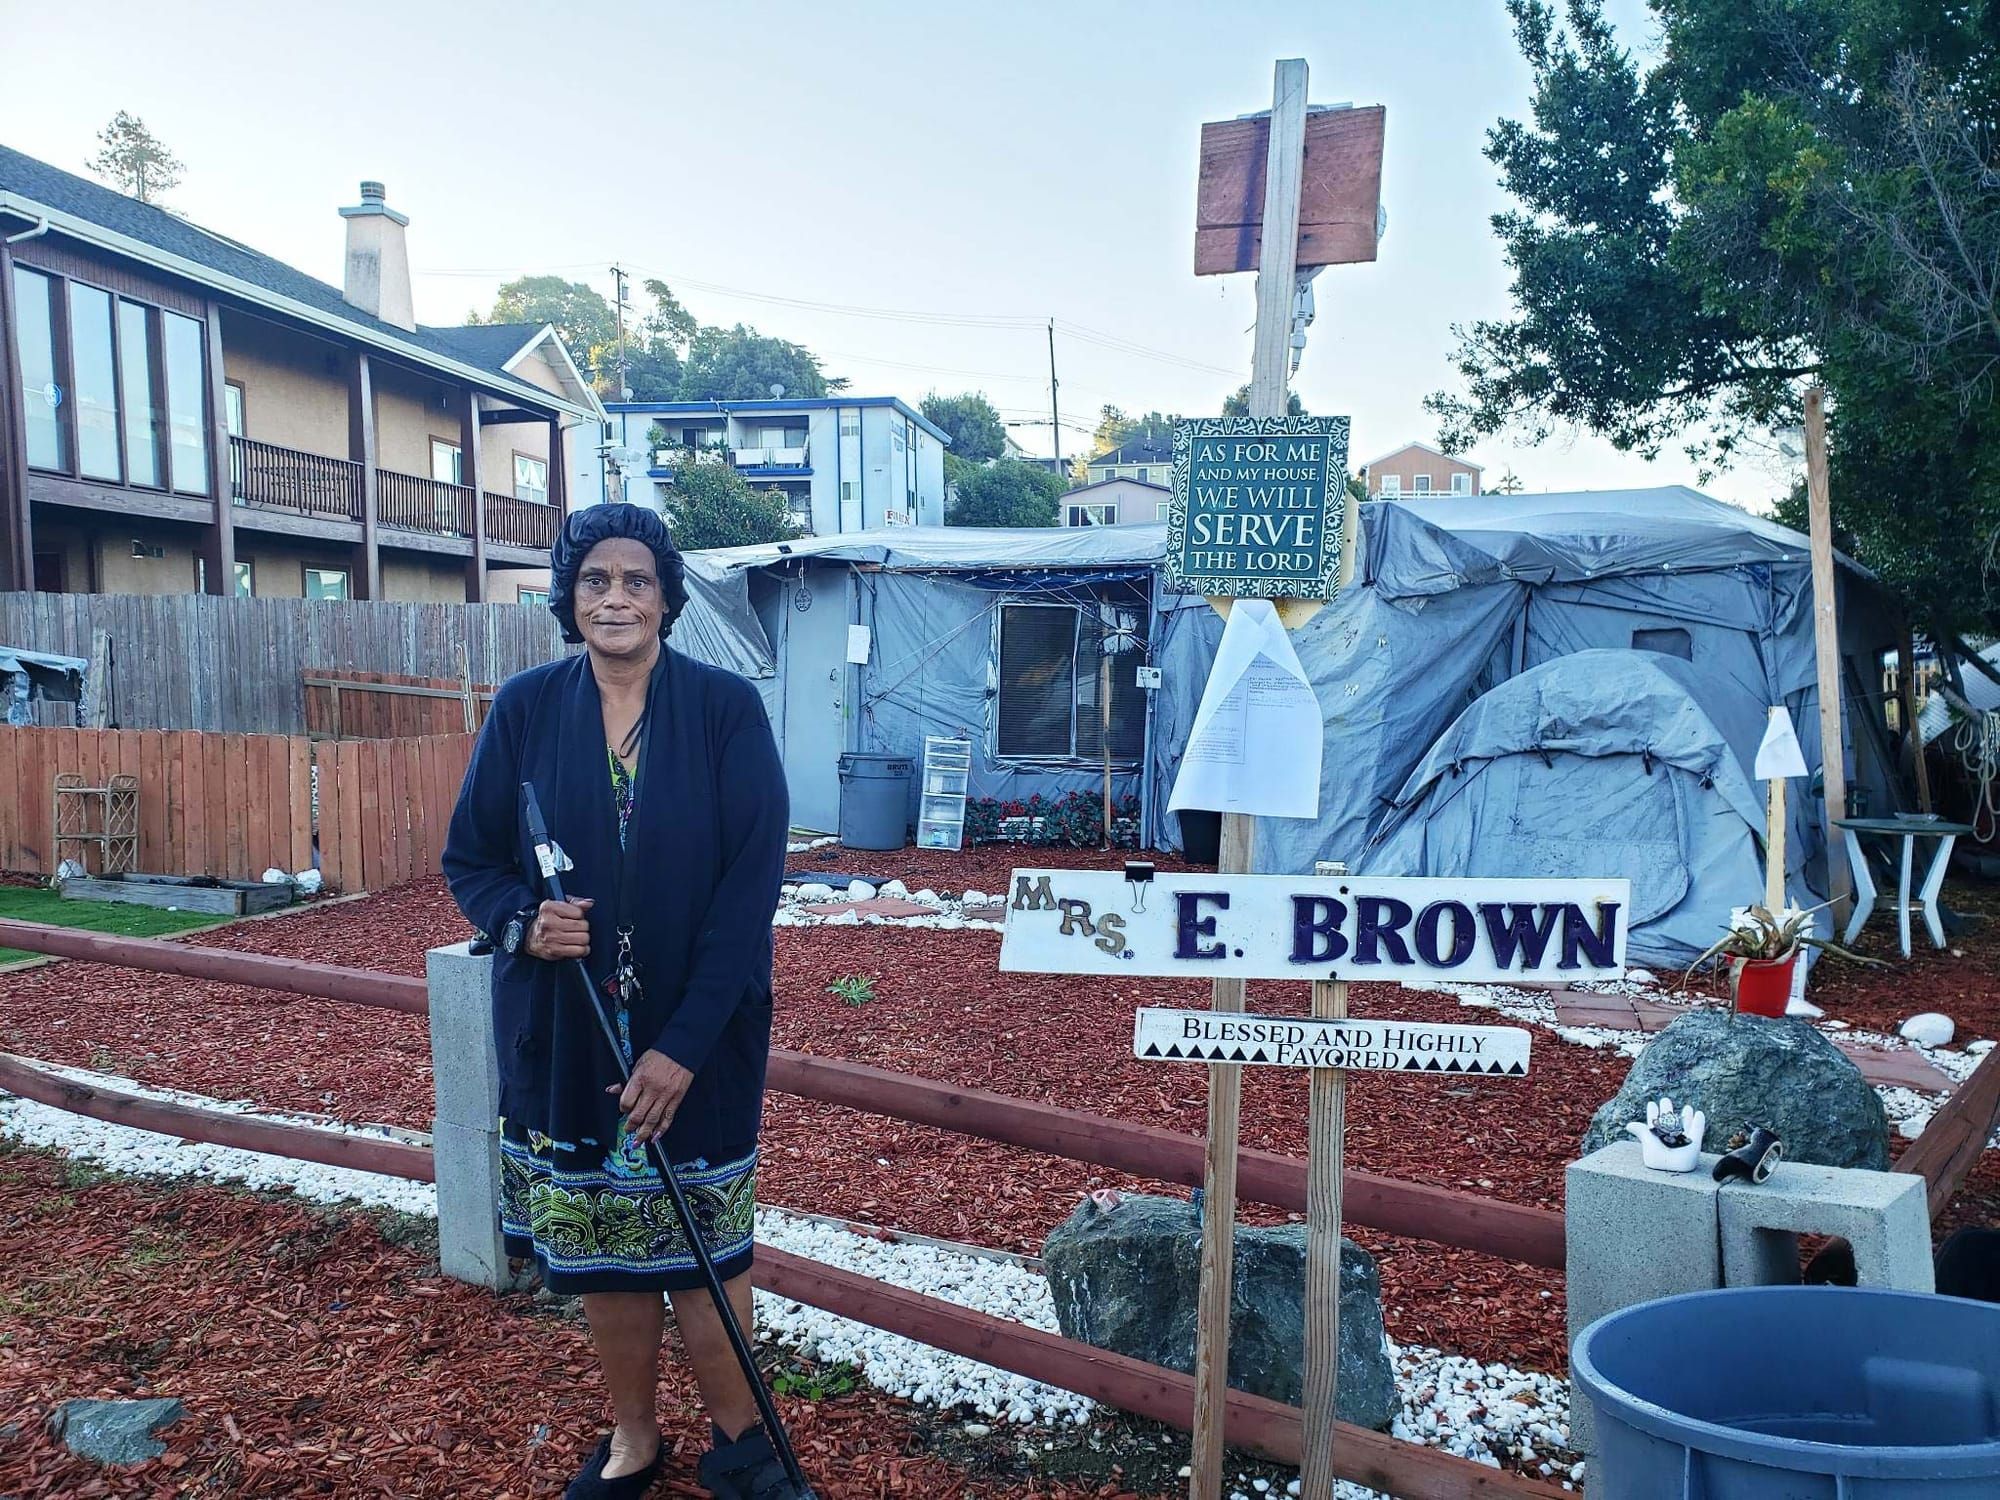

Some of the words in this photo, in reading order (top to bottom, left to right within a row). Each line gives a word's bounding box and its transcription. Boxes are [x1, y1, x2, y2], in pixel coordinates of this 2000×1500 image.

[1197, 444, 1226, 462] AS
[1234, 443, 1280, 462] FOR
[1286, 443, 1321, 462] ME
[1196, 468, 1232, 481] AND
[1236, 468, 1260, 481] MY
[1264, 468, 1320, 482] HOUSE,
[1195, 486, 1238, 509] WE
[1246, 486, 1318, 509] WILL
[1191, 513, 1314, 547] SERVE
[1190, 551, 1236, 569] THE
[1245, 552, 1313, 571] LORD
[1173, 890, 1244, 960] E.
[1288, 894, 1622, 970] BROWN
[1183, 1018, 1305, 1044] BLESSED
[1314, 1028, 1372, 1048] AND
[1383, 1029, 1487, 1053] HIGHLY
[1276, 1043, 1399, 1069] FAVORED
